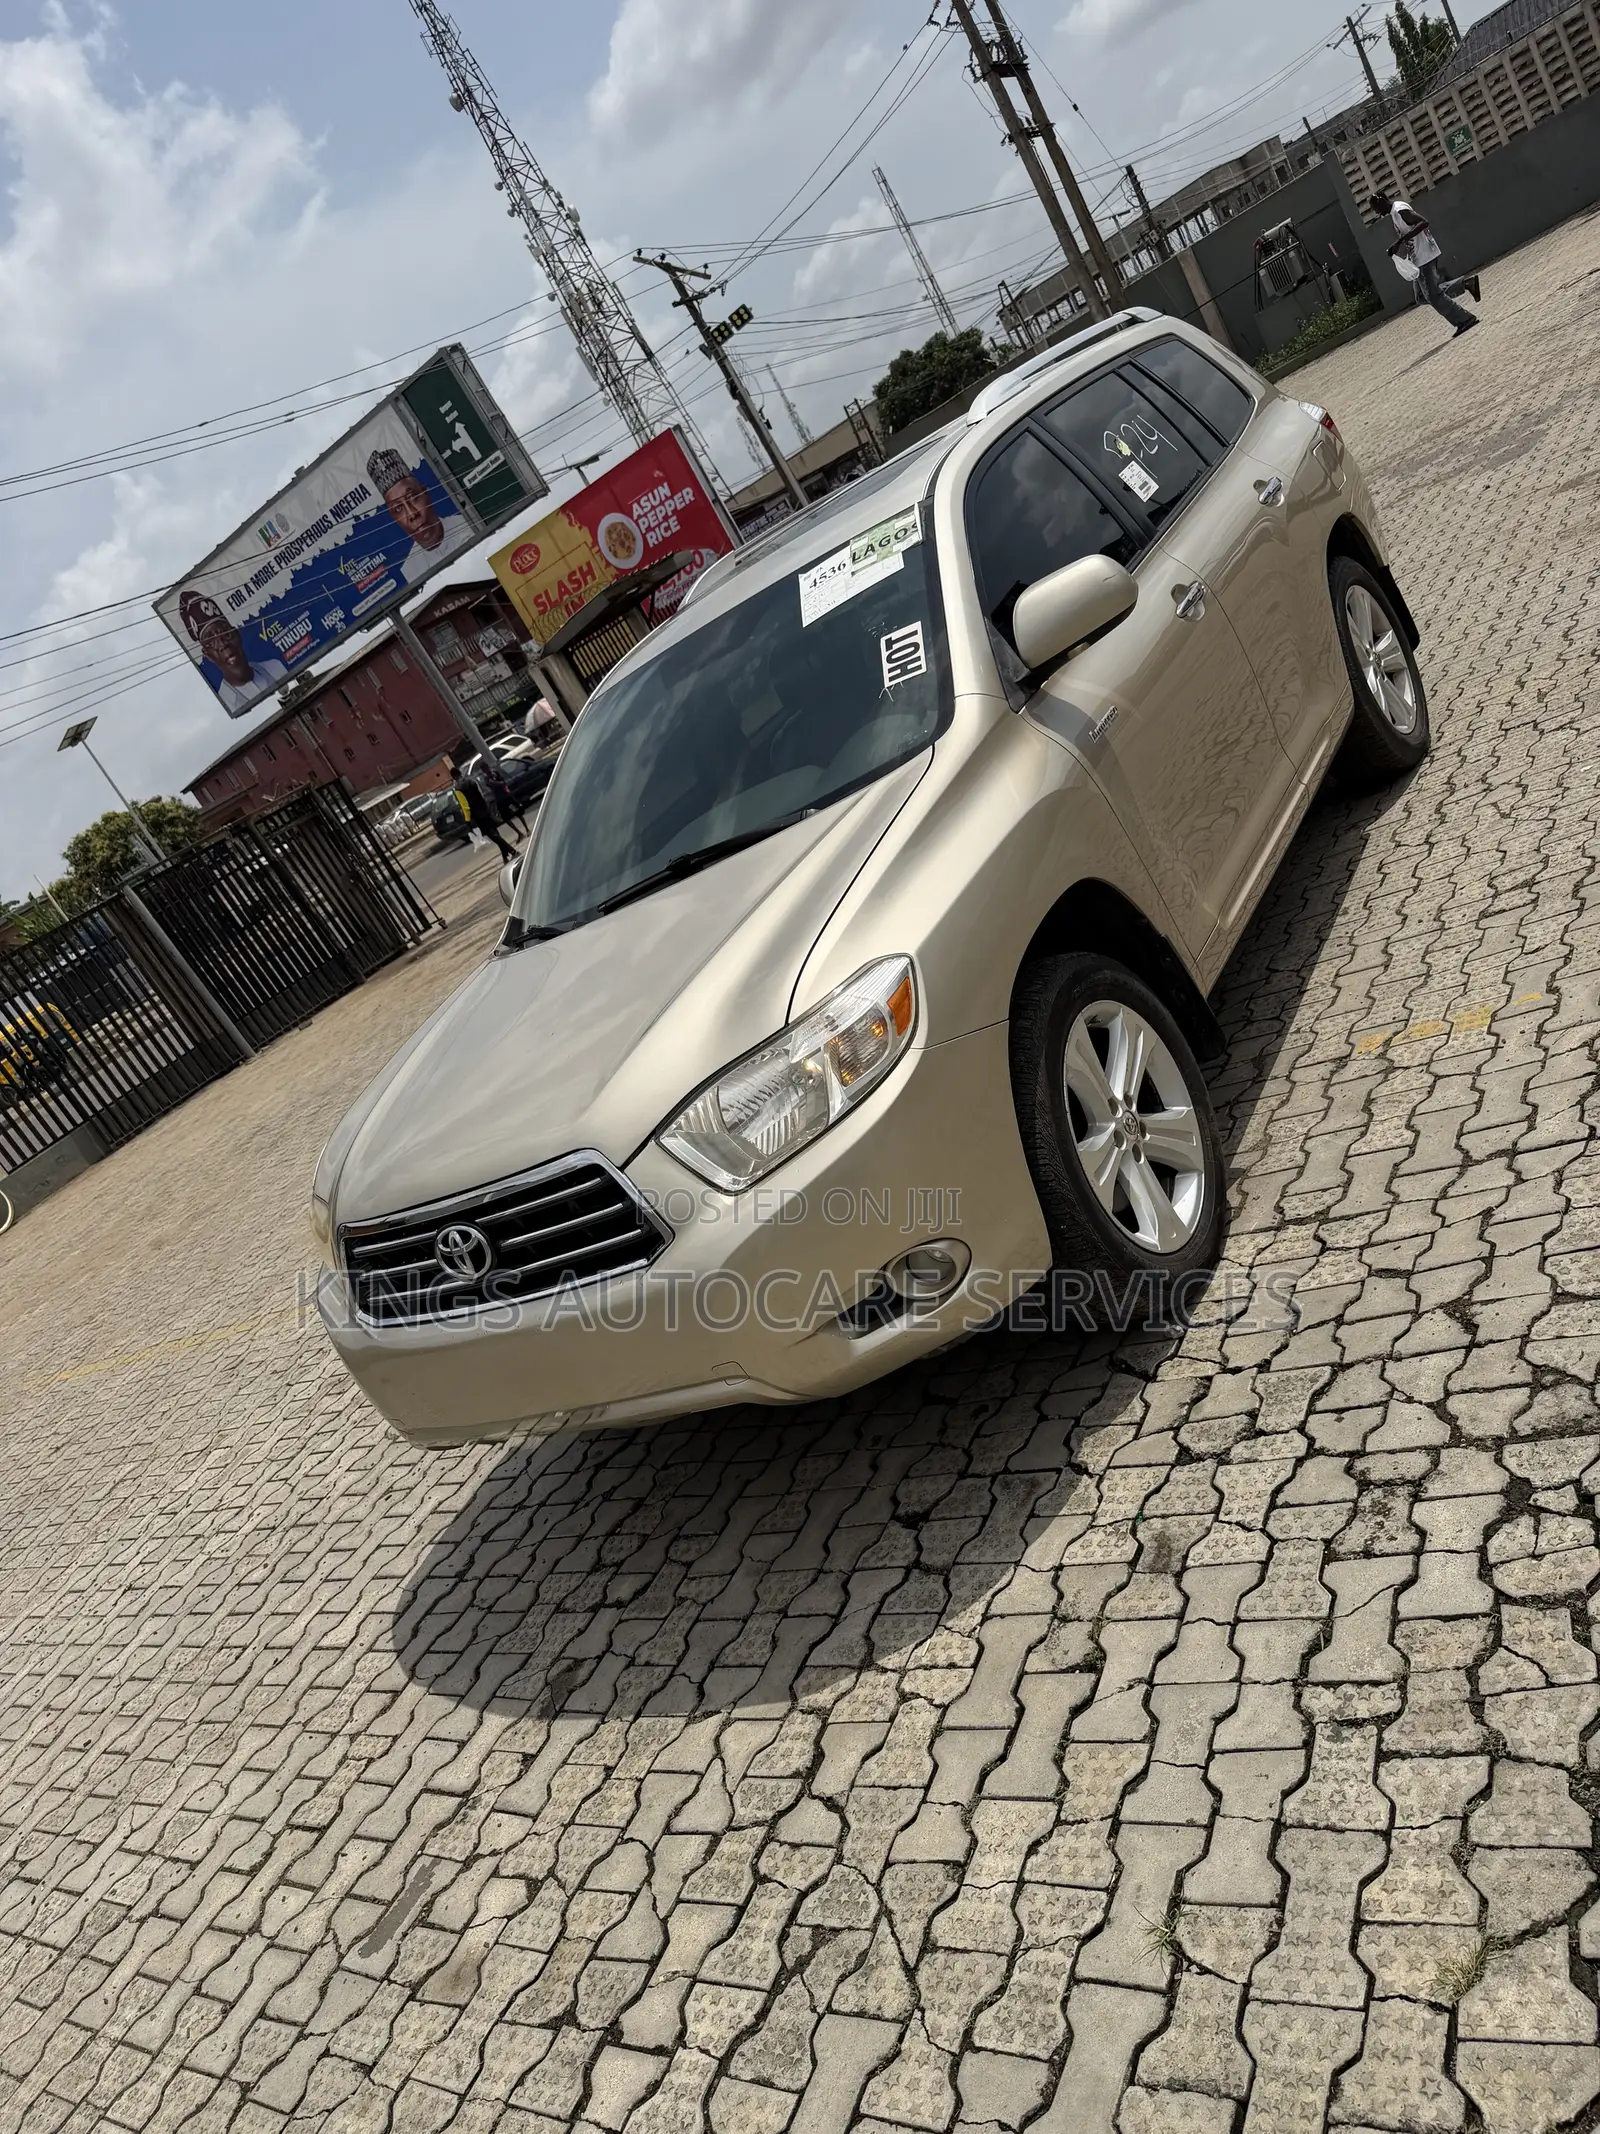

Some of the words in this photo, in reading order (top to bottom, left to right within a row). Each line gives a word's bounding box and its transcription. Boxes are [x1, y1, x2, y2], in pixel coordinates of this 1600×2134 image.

[329, 482, 372, 527] NIGERIA
[632, 482, 672, 520] ASUN
[638, 487, 696, 534] PEPPER
[274, 514, 334, 570] PROSPEROUS
[646, 515, 681, 548] RICE
[250, 561, 279, 593] MORE
[351, 552, 387, 583] SHETTIMA
[809, 560, 847, 590] 4536
[226, 591, 248, 611] FOR
[246, 582, 255, 597] A
[533, 560, 597, 615] SLASH
[275, 618, 313, 652] TINUBU
[885, 629, 923, 683] HOT
